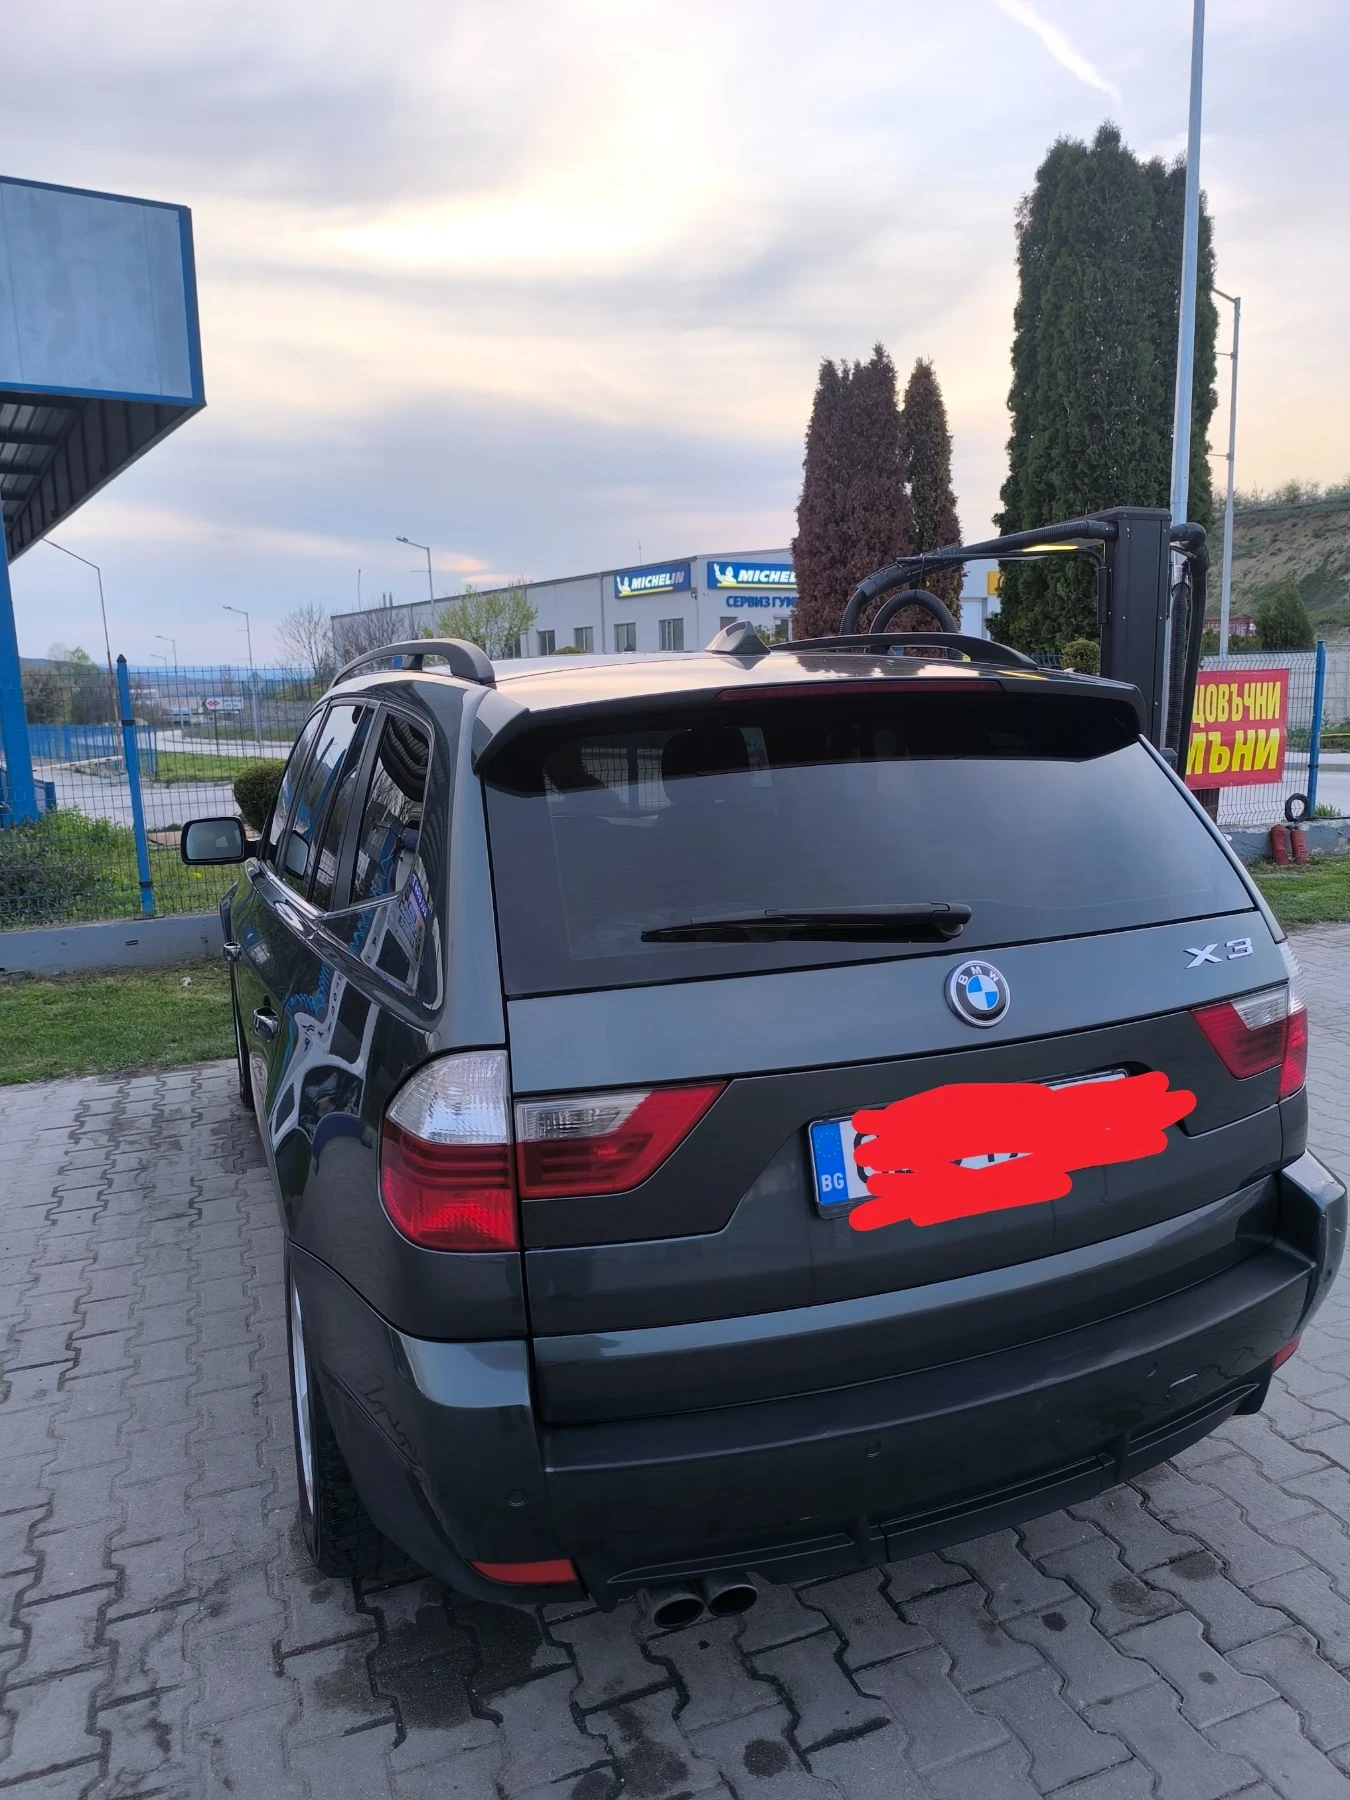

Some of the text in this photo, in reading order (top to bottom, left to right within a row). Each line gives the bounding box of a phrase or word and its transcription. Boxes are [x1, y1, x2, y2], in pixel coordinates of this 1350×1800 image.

[631, 571, 685, 590] MICHELIN
[726, 595, 771, 608] СЕРВИЗ
[1192, 681, 1281, 728] ЦОВЪЧНИ
[1183, 937, 1253, 969] X3
[958, 965, 999, 986] BMW
[821, 1172, 845, 1192] BG
